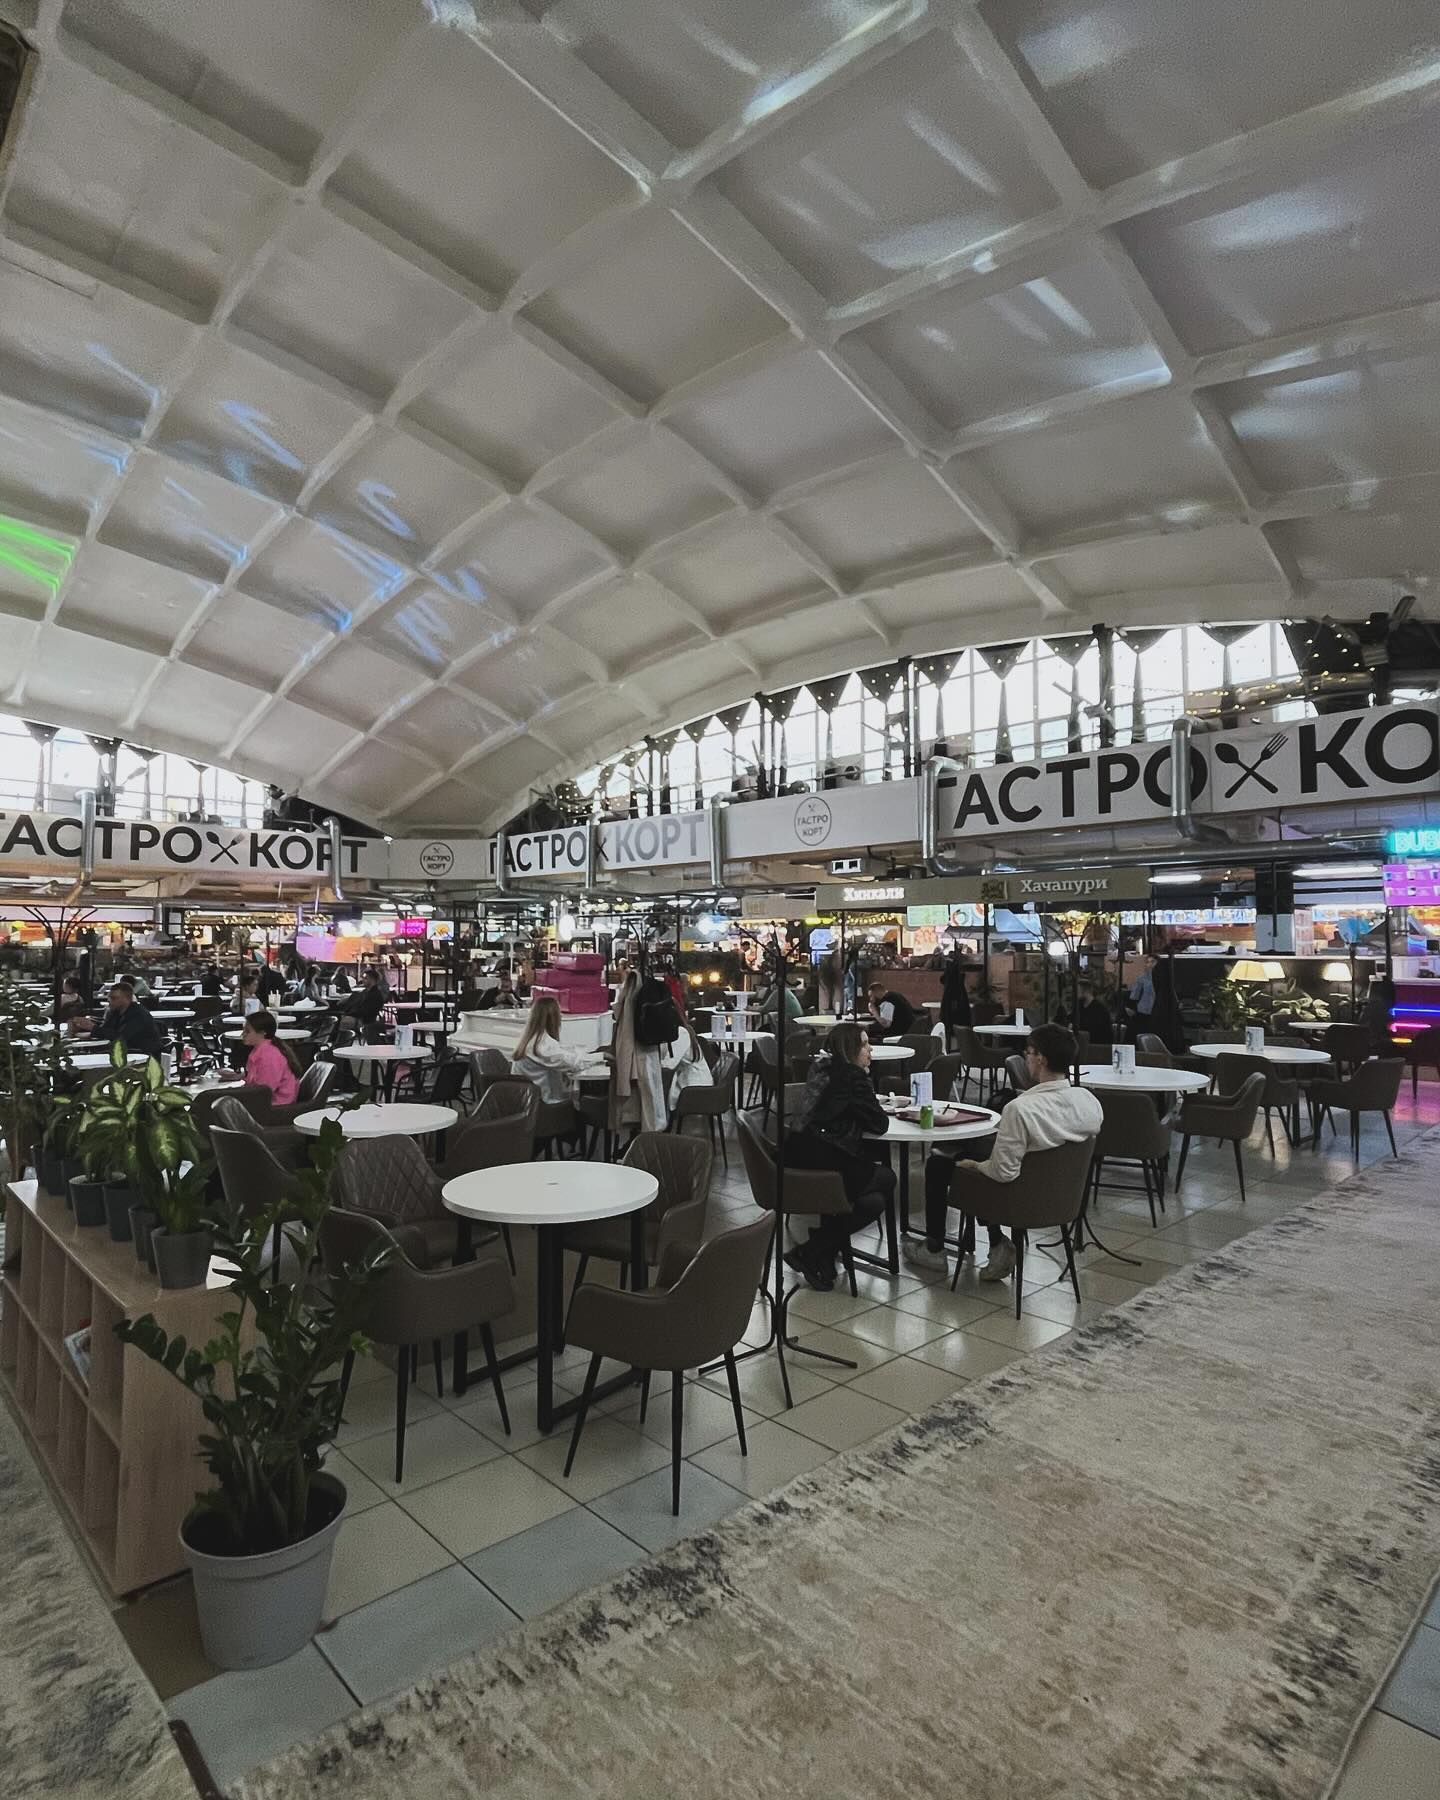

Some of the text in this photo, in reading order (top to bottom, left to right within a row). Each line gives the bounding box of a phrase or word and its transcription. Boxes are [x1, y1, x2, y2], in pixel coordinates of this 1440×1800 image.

[1299, 709, 1440, 794] КО
[797, 814, 829, 826] ГАСТРО
[615, 814, 705, 864] КОРТ
[802, 827, 823, 836] КОРТ
[0, 813, 367, 873] АСТРО КОРТ
[843, 887, 905, 902] Хинкали
[1020, 878, 1108, 895] Хачапури
